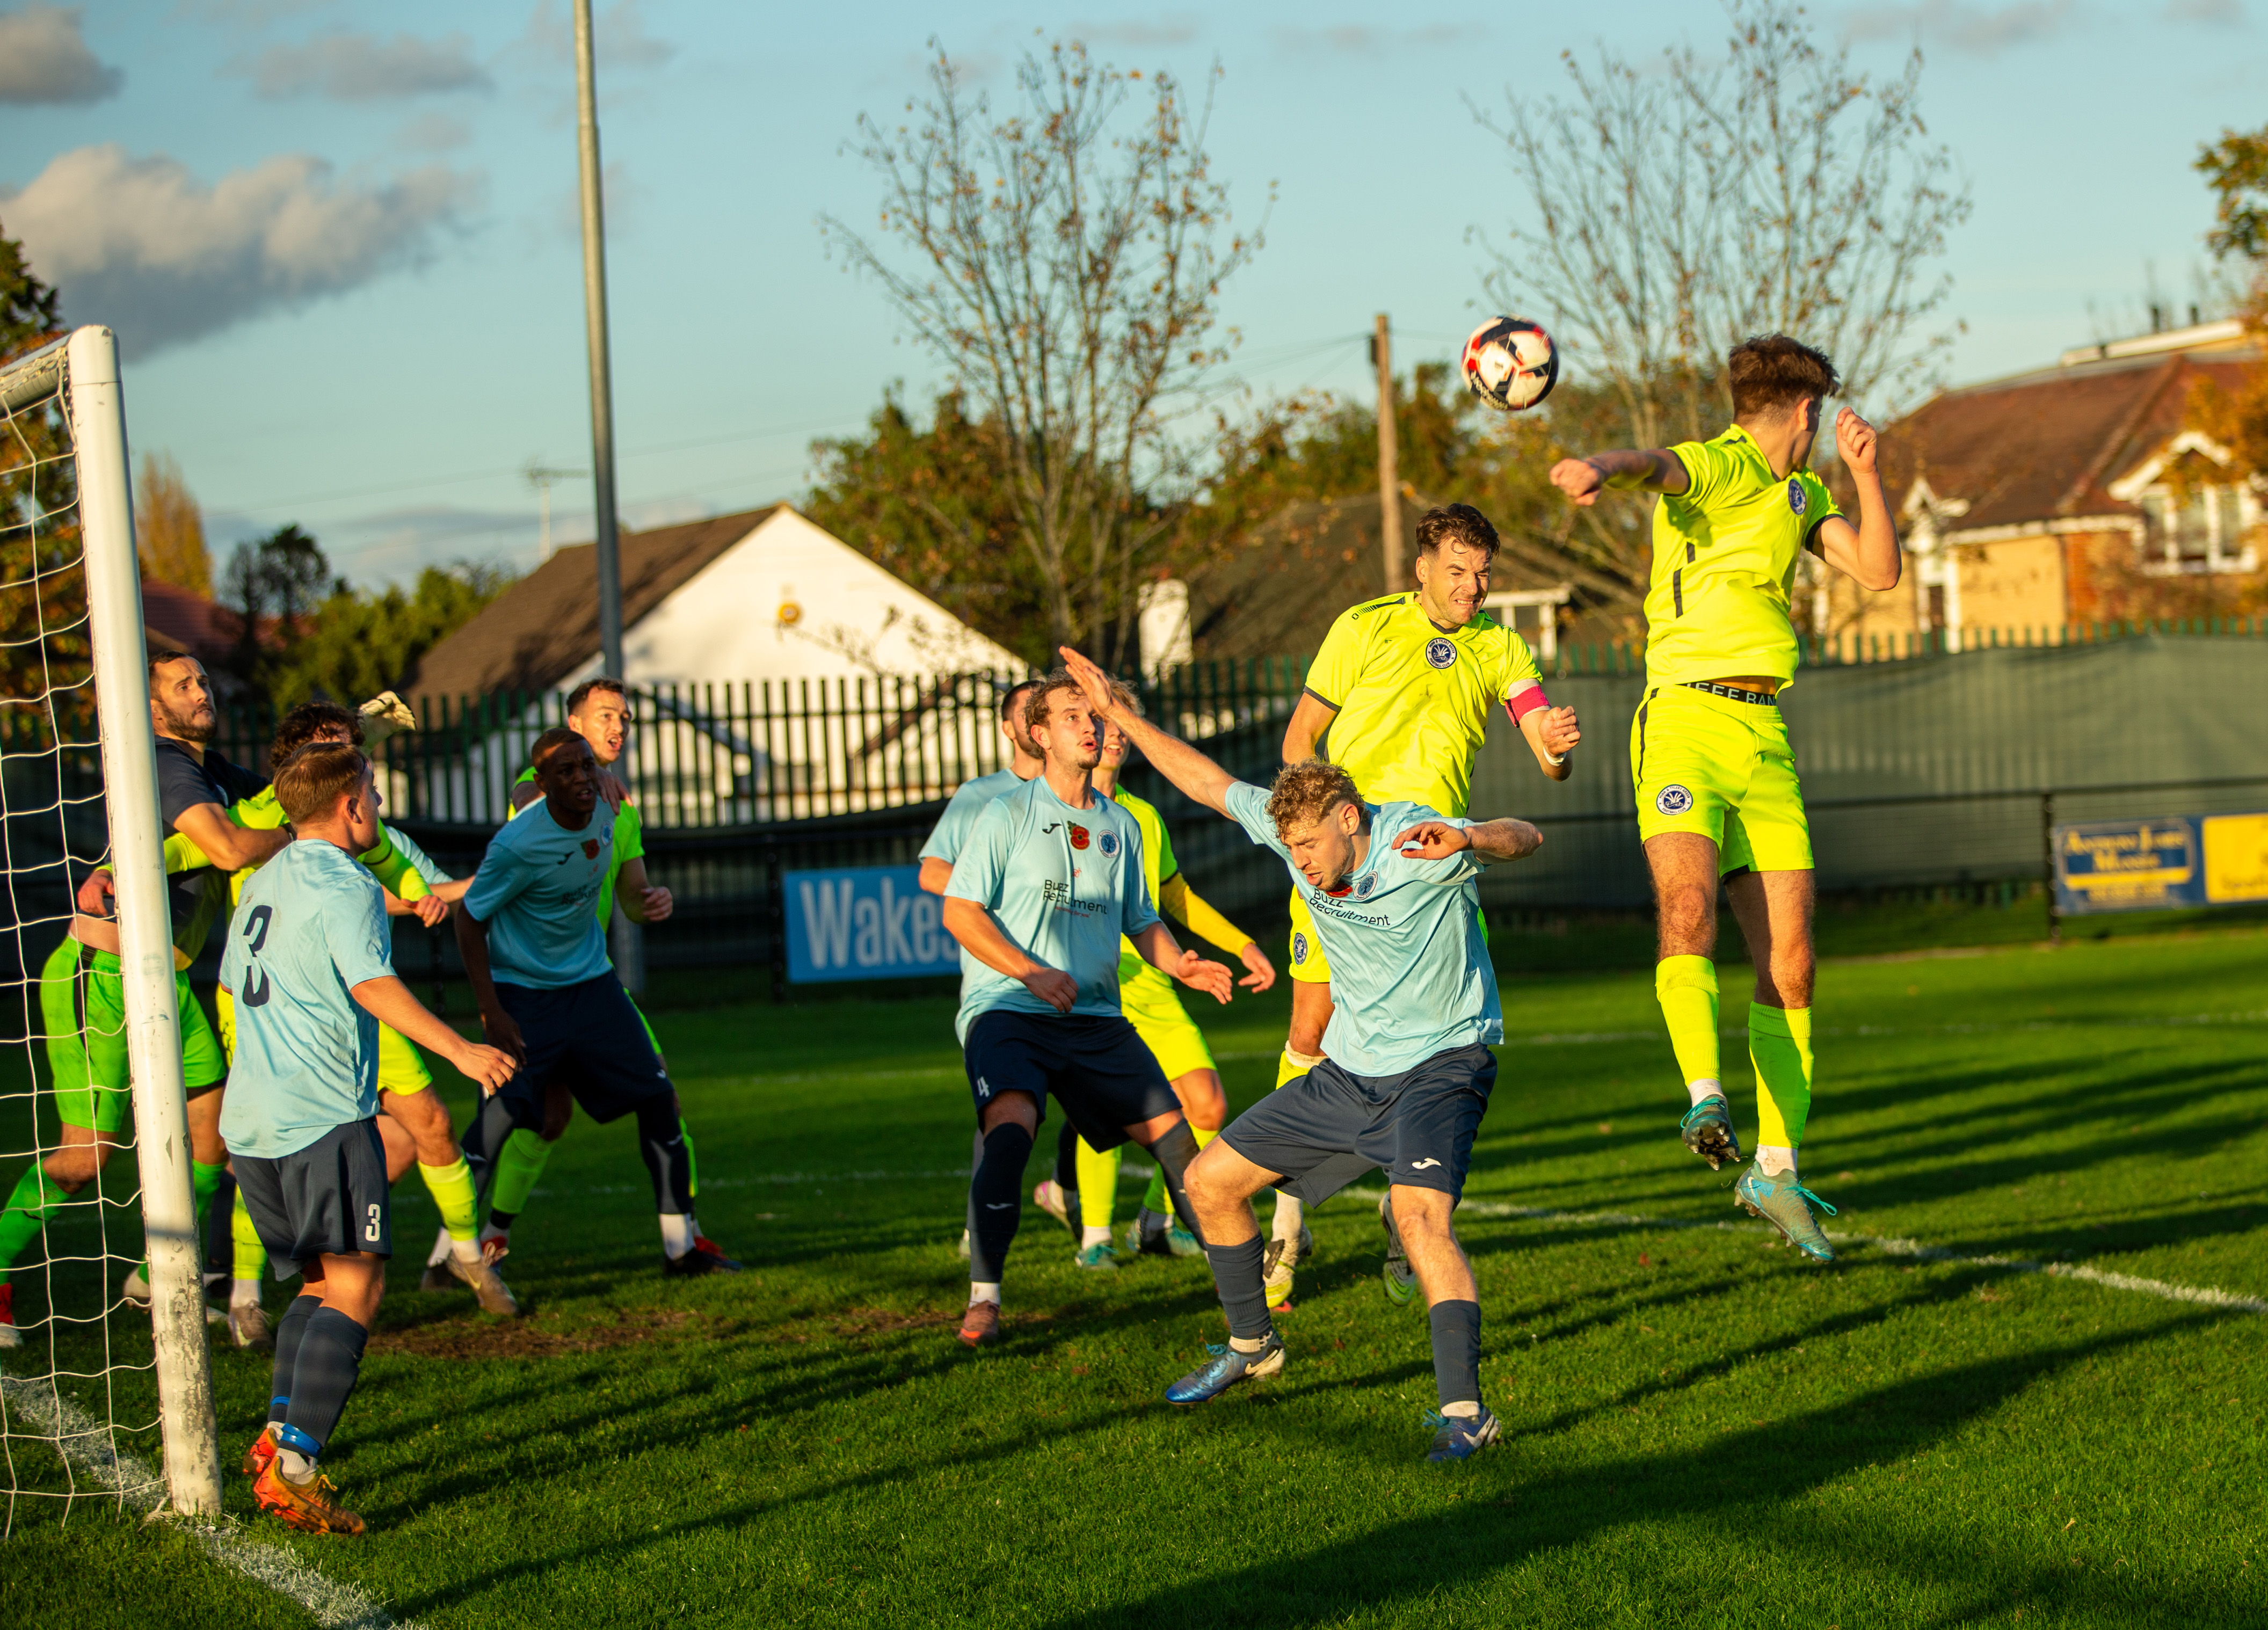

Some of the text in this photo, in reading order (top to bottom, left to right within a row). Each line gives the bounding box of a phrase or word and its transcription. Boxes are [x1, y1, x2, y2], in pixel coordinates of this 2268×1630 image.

[1043, 891, 1107, 915] Recrutment
[1309, 898, 1391, 926] Recruitment
[242, 905, 273, 1008] 3
[977, 1076, 990, 1097] 4
[365, 1204, 381, 1242] 3
